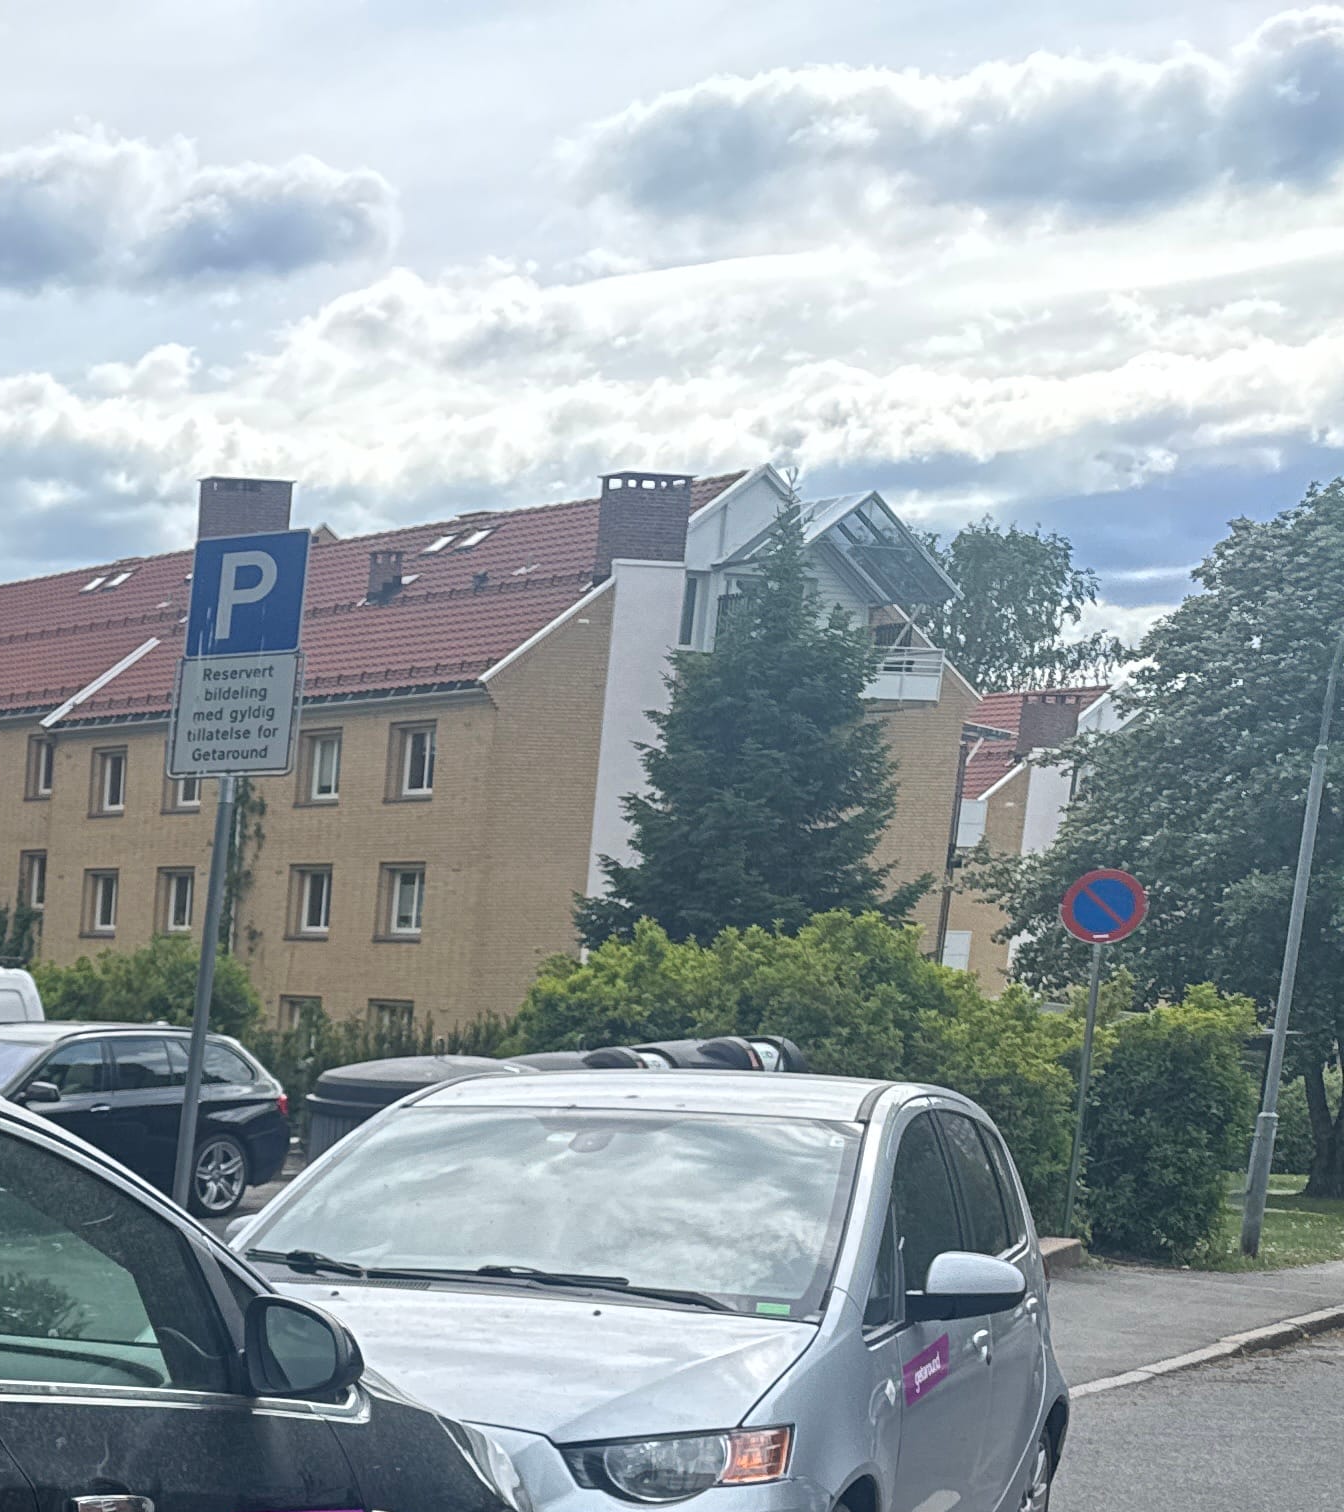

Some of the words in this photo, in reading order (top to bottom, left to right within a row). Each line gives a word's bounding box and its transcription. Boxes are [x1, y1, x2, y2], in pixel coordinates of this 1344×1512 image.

[214, 550, 279, 640] P
[202, 665, 275, 681] Reservert
[204, 685, 268, 702] bildeling
[192, 706, 224, 721] med
[229, 705, 276, 723] gyldig
[187, 727, 251, 742] tillatelse
[257, 724, 279, 739] for
[191, 745, 269, 762] Getaround
[915, 1350, 941, 1394] getaround
